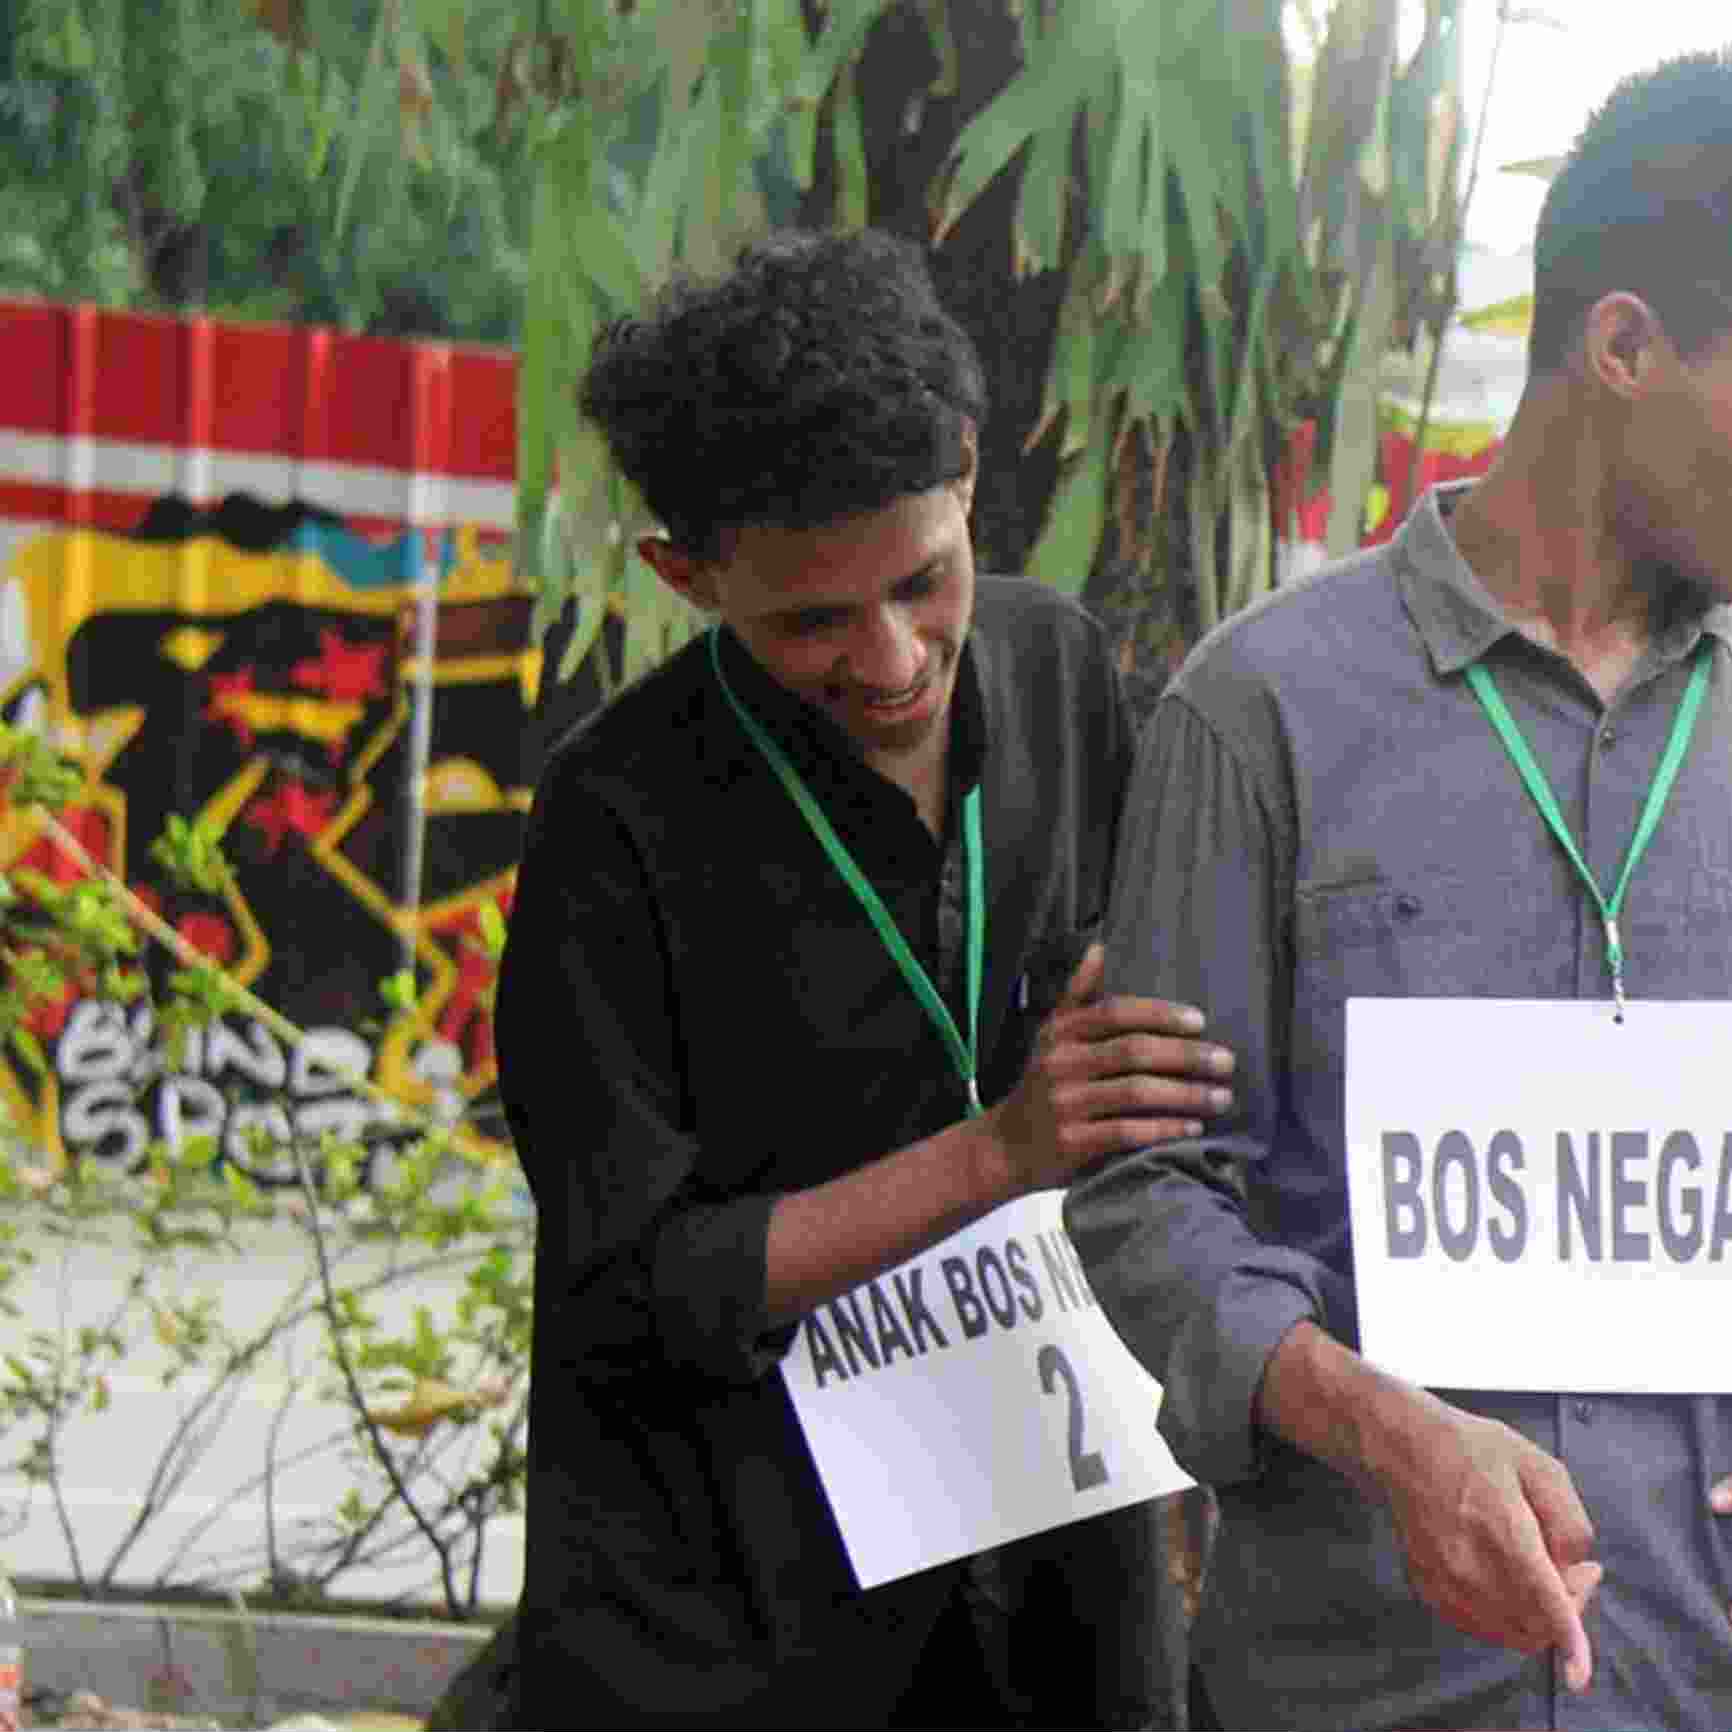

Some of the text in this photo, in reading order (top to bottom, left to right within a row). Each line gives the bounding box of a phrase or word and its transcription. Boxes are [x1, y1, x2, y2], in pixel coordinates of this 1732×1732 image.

[1381, 1128, 1528, 1264] BOS
[804, 1267, 950, 1389] ANAK
[941, 1237, 1044, 1341] BOS
[1036, 1343, 1110, 1494] 2
